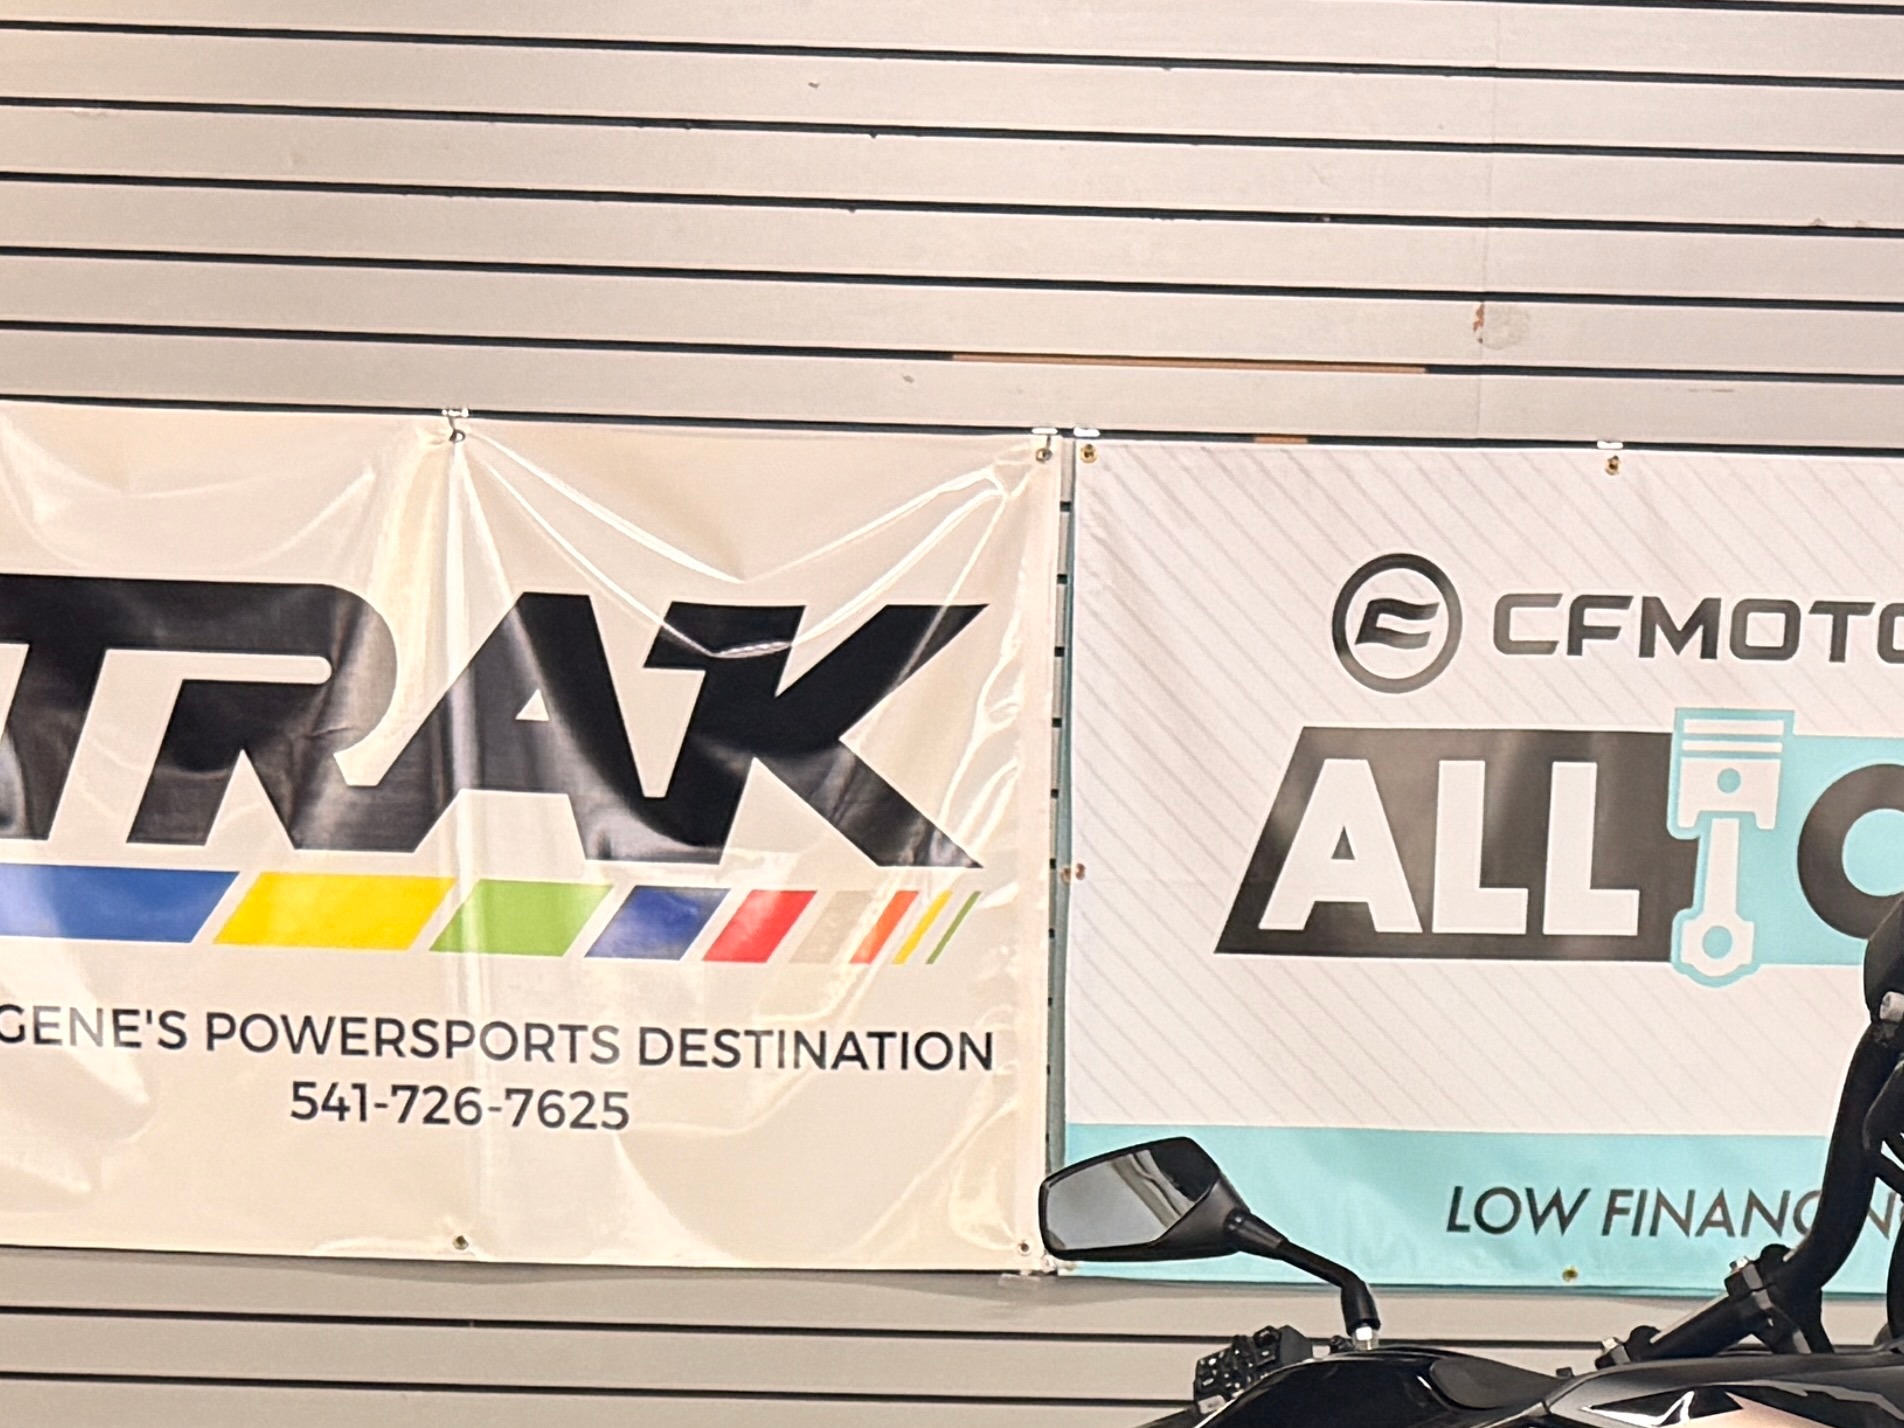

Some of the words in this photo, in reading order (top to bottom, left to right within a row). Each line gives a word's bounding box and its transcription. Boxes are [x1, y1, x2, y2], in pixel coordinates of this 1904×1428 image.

[1258, 759, 1640, 937] ALL
[206, 1011, 621, 1066] POWERSPORTS
[638, 1025, 995, 1072] DESTINATION
[289, 1080, 630, 1132] 541-726-7625
[1446, 1185, 1591, 1237] LOW
